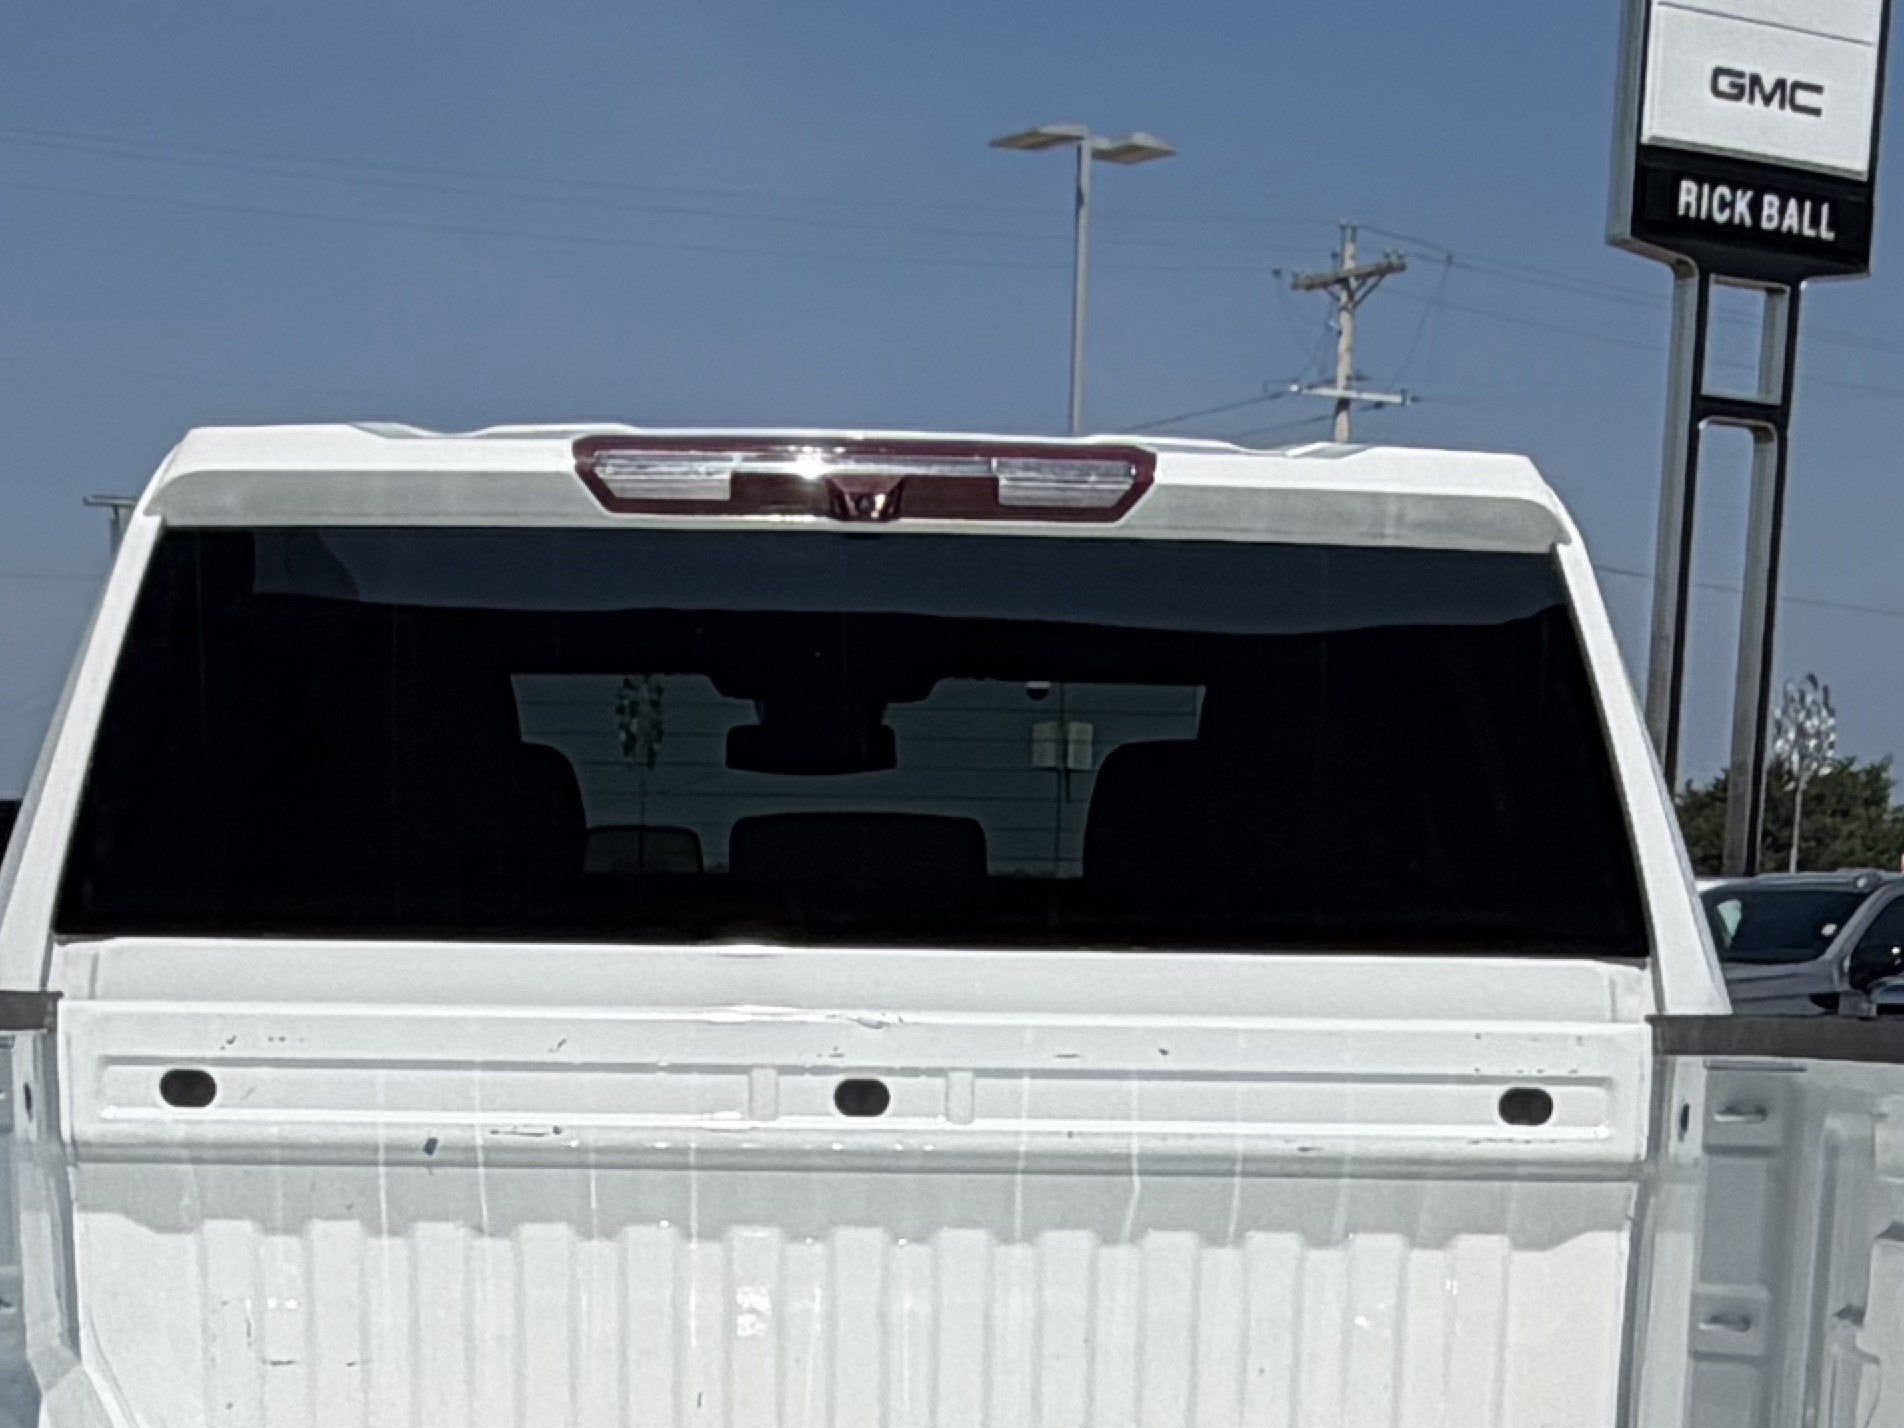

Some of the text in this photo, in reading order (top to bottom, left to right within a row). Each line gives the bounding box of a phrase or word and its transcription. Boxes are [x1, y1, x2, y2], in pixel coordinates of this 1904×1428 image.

[1710, 66, 1825, 117] GMC
[1677, 179, 1836, 242] RICK BALL
